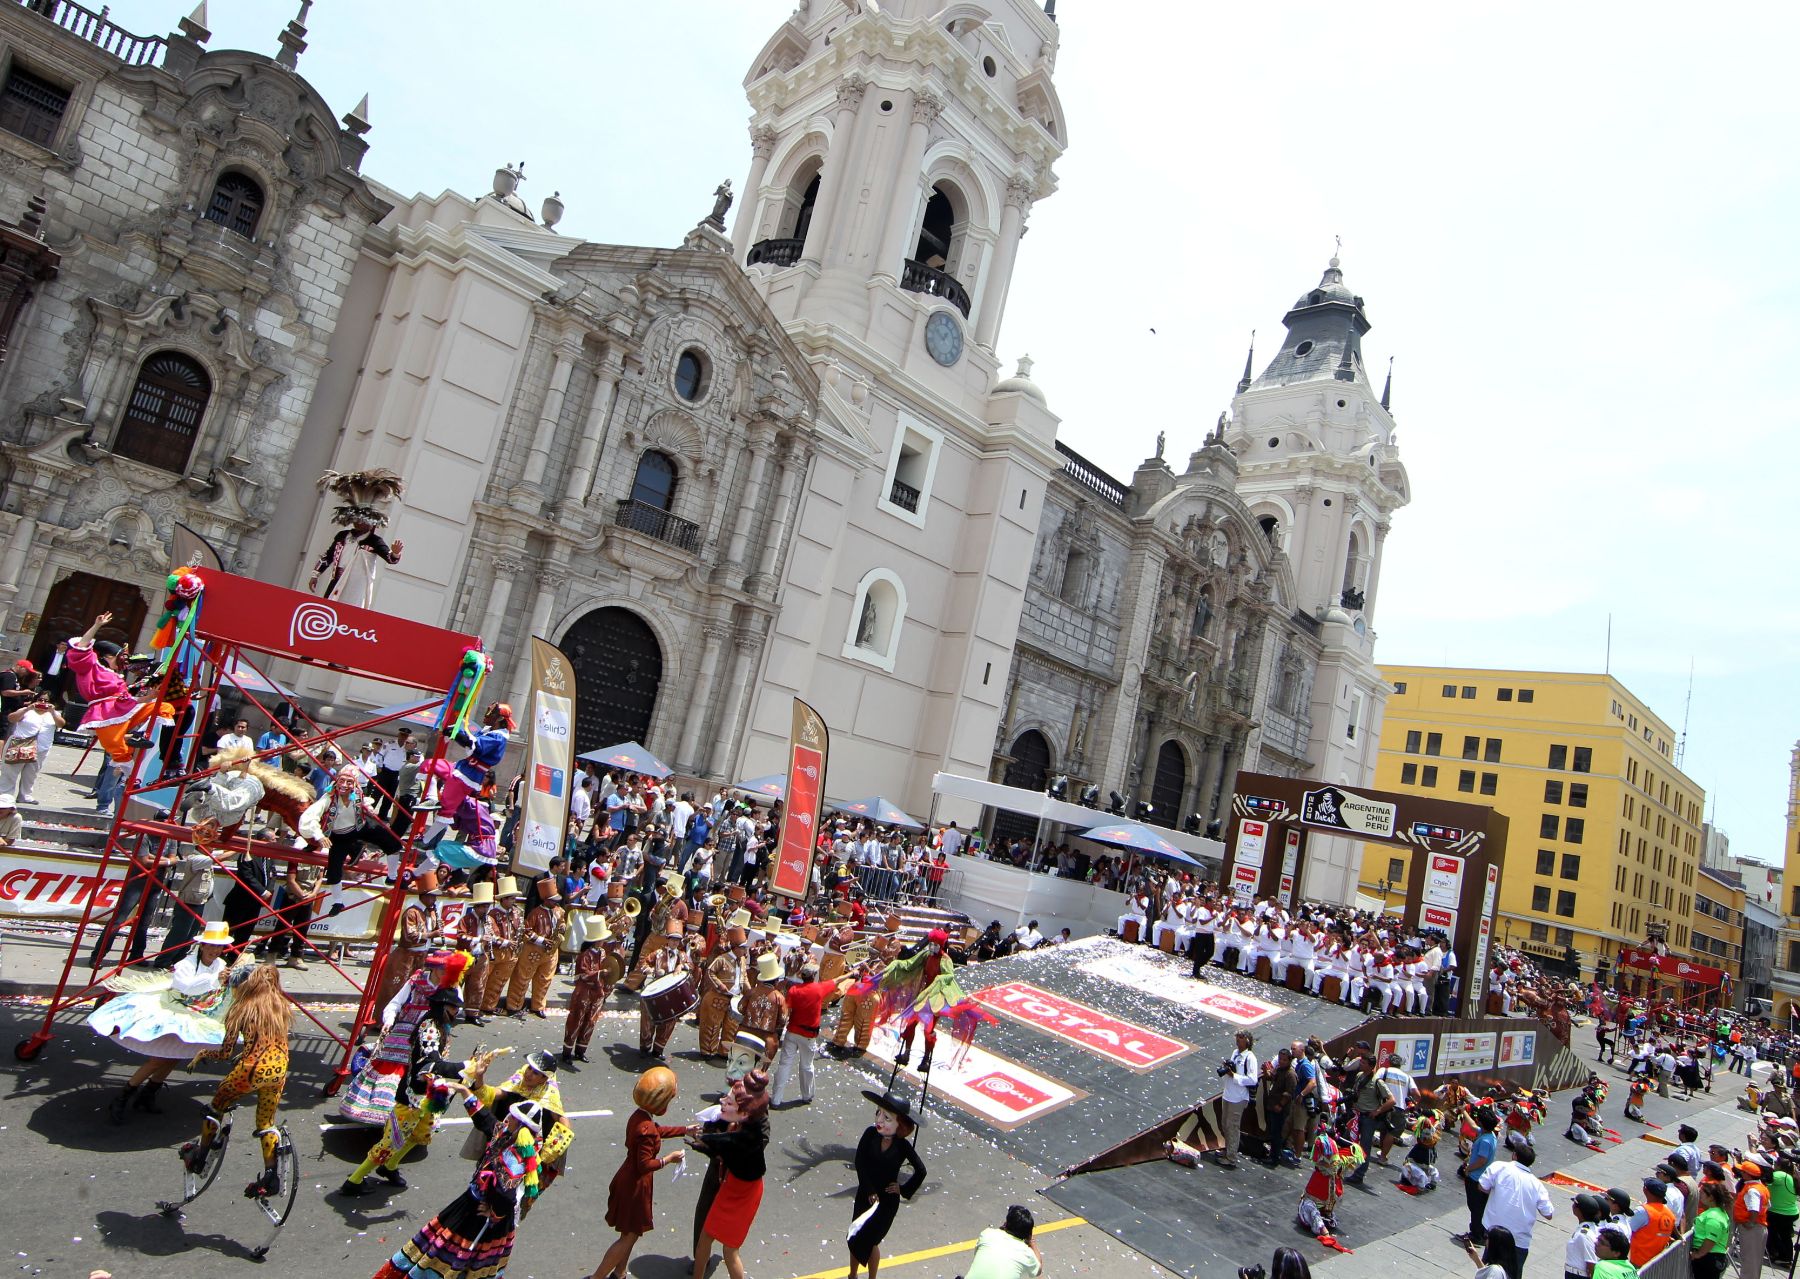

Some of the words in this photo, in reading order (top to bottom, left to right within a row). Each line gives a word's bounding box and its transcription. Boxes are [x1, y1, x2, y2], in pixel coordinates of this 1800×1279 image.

[1306, 796, 1314, 819] 2012
[1343, 802, 1391, 815] ARGENTINA
[1366, 813, 1389, 823] CHILE
[1365, 821, 1389, 831] PERU
[1237, 870, 1255, 879] TOTAL
[1426, 911, 1450, 924] TOTAL
[1002, 987, 1155, 1061] TOTAL
